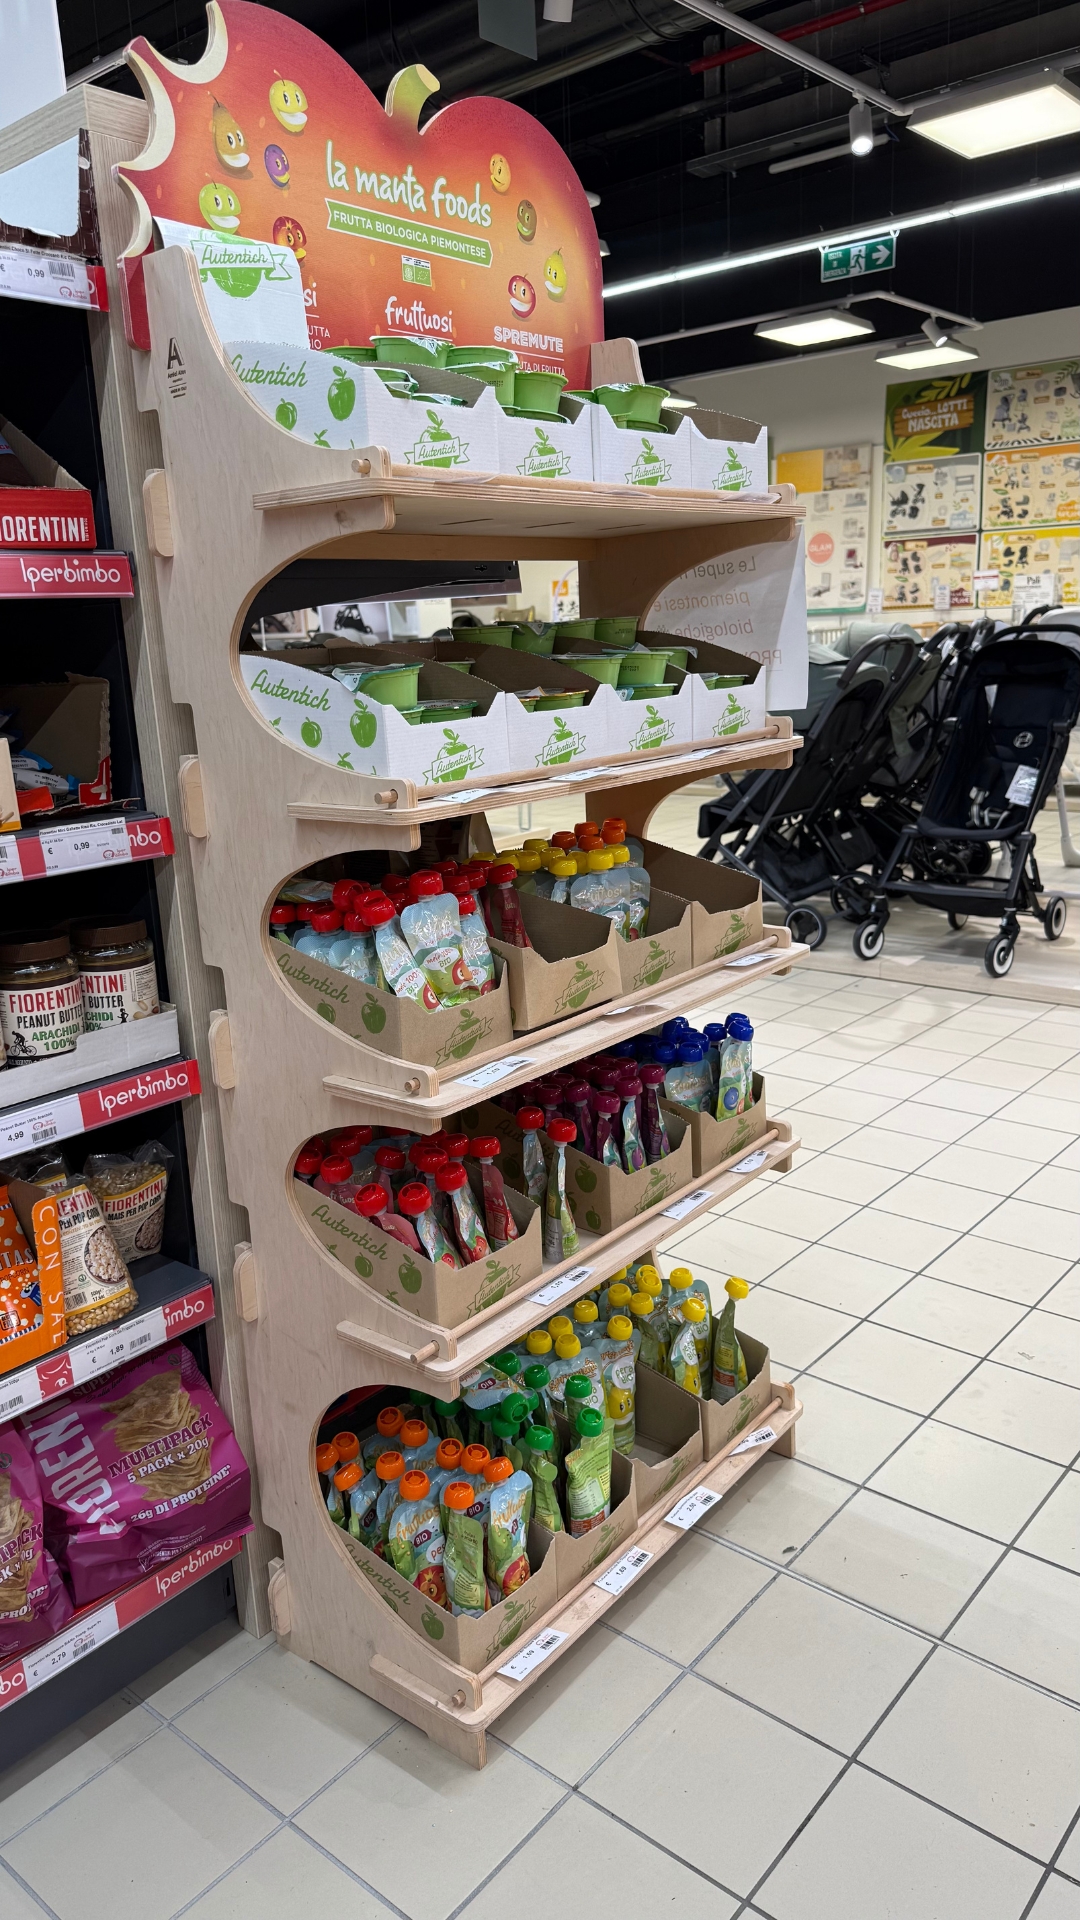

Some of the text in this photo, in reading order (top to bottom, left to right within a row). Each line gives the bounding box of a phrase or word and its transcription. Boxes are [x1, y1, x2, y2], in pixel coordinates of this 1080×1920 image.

[327, 140, 492, 227] la manta foods
[333, 210, 487, 258] FRUTTA BIOLOGICA PIEMONTESE
[202, 245, 268, 264] Autentich
[27, 268, 45, 278] 0,99
[385, 296, 453, 333] fruttuosi
[307, 325, 331, 338] UTTA
[494, 326, 563, 353] SPREMUTE
[167, 337, 185, 370] A
[518, 361, 532, 372] UTA
[541, 365, 566, 377] FRUTTA
[937, 399, 968, 413] LOTTI
[908, 412, 959, 433] NASCITA
[417, 444, 457, 462] Autentich
[528, 456, 561, 474] Autentich
[634, 465, 664, 480] Autentich
[0, 516, 86, 542] ORENTINI
[808, 544, 833, 553] GLAM
[20, 558, 121, 592] Iperbimbo
[250, 669, 332, 711] Autentich
[720, 711, 744, 730] Autentich
[638, 724, 667, 744] Autentich
[546, 736, 576, 759] Autentich
[435, 752, 473, 776] Autentich
[129, 825, 161, 847] mbo
[74, 842, 90, 851] 0,99
[439, 958, 452, 969] BIO
[80, 974, 124, 994] ENTINI
[277, 953, 350, 1003] Autentich
[9, 977, 81, 1013] FIORENTIN
[88, 995, 124, 1009] BUTTER
[17, 1004, 83, 1029] PEANUT BUTTE
[85, 1012, 114, 1022] CHIDI
[32, 1022, 81, 1042] ARACHIDI
[44, 1036, 75, 1051] 100%
[98, 1070, 188, 1117] Iperbimbo
[7, 1131, 24, 1142] 4,99
[105, 1178, 164, 1212] FIORENTINI
[72, 1212, 85, 1224] POP
[107, 1211, 124, 1221] MAIS
[126, 1208, 137, 1217] PER
[138, 1203, 149, 1214] POP
[40, 1205, 61, 1270] CON
[311, 1204, 388, 1260] Autentich
[166, 1299, 205, 1327] imbo
[696, 1324, 709, 1335] BIO
[110, 1343, 124, 1355] 1,89
[616, 1365, 633, 1379] pera
[72, 1370, 114, 1397] SUPER
[480, 1380, 493, 1390] BIO
[108, 1412, 213, 1478] MULTIPACK
[126, 1438, 209, 1484] 5 PACK x 20g
[131, 1508, 153, 1522] 26g
[155, 1502, 170, 1516] DI
[365, 1511, 375, 1524] BIO
[469, 1505, 481, 1516] BIO
[395, 1504, 441, 1545] fruttuos
[416, 1531, 428, 1545] BIO
[156, 1539, 233, 1597] Iperbimbo
[52, 1651, 66, 1665] 2,79
